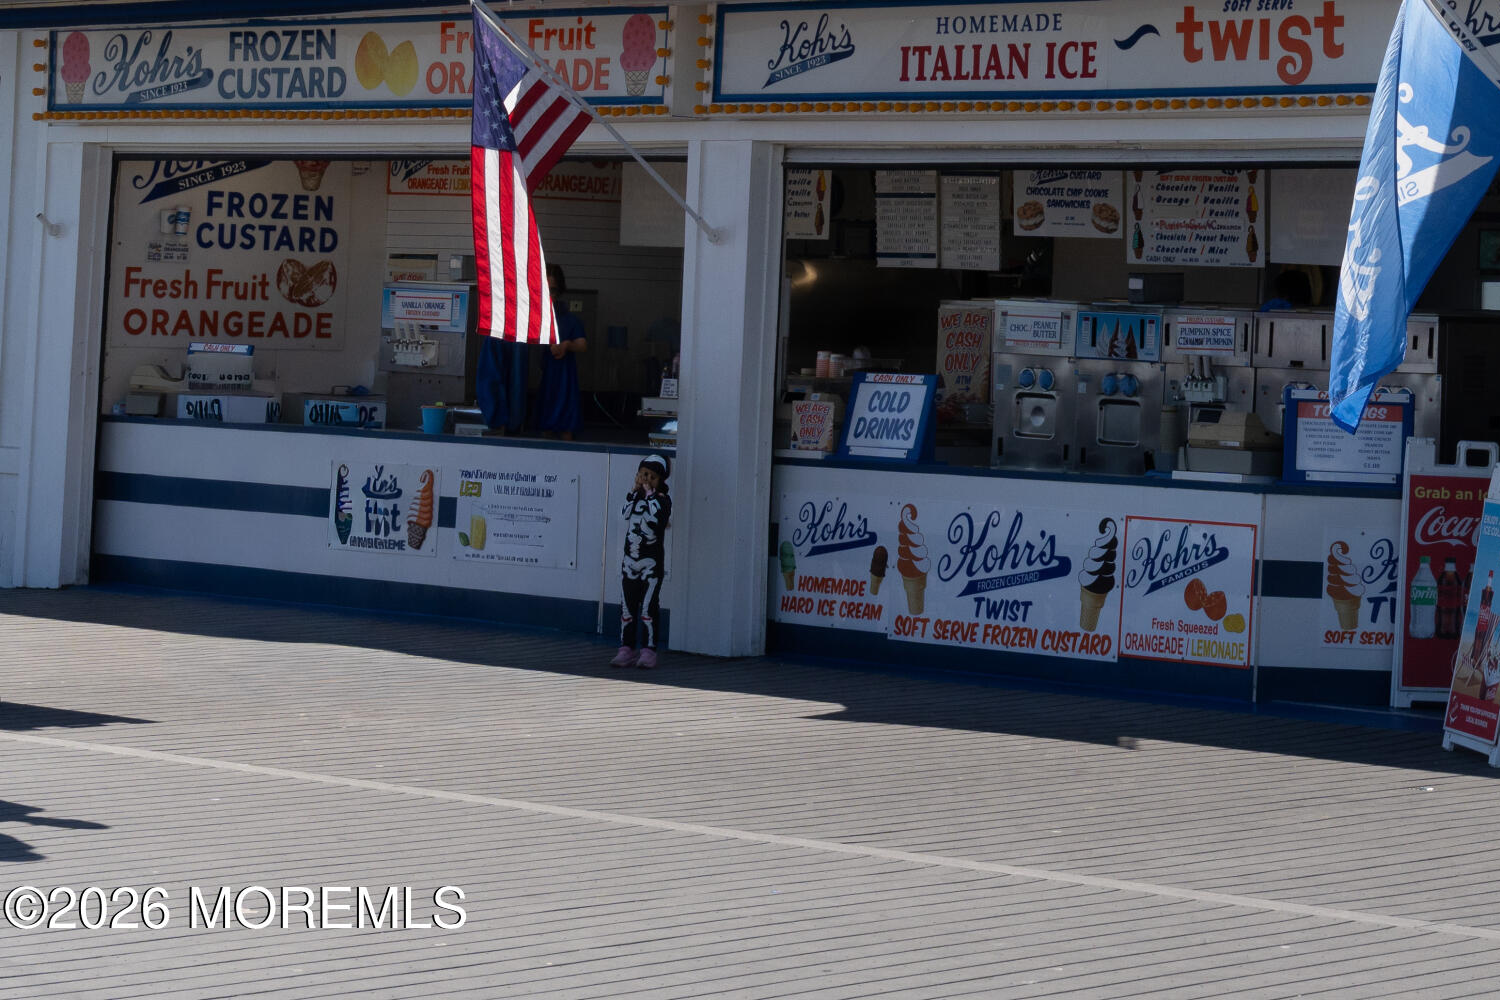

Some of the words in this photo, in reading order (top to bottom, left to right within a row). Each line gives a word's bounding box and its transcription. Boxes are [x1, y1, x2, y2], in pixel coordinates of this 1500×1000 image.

[528, 17, 596, 51] Fruit
[936, 13, 1063, 34] HOMEMADE
[229, 29, 337, 61] FROZEN
[768, 13, 853, 70] Kohr's
[93, 30, 204, 96] Kohr's
[775, 63, 801, 80] SINCE
[806, 55, 826, 70] 1923
[900, 43, 1031, 82] ITALIAN
[1045, 41, 1098, 79] ICE
[140, 85, 168, 100] SINCE
[170, 81, 189, 94] 1923
[217, 67, 347, 100] CUSTARD
[178, 170, 214, 191] SINCE
[220, 160, 247, 178] 1923
[427, 164, 449, 175] Fresh
[452, 165, 470, 175] Fruit
[407, 178, 448, 190] ORANGEADE
[1026, 187, 1065, 197] CHOCOLATE
[1066, 188, 1083, 197] CHIP
[1084, 188, 1109, 198] COOKIE
[1156, 183, 1197, 192] Chocolate
[1208, 184, 1240, 192] Vanilla
[206, 190, 334, 221] FROZEN
[1046, 198, 1091, 209] SANDWICHES
[1156, 195, 1190, 206] Orange
[1203, 195, 1240, 205] Vanilla
[1209, 208, 1240, 217] Vanilla
[196, 222, 338, 253] CUSTARD
[1156, 232, 1187, 241] Chocolate
[1195, 233, 1217, 241] Peanut
[1219, 233, 1240, 242] Butter
[1156, 244, 1197, 254] Chocolate
[1208, 245, 1229, 255] Mint
[124, 267, 198, 299] Fresh
[206, 269, 269, 300] Fruit
[123, 308, 333, 338] ORANGEADE
[940, 312, 959, 330] WE
[963, 312, 989, 329] ARE
[1033, 320, 1058, 330] PEANUT
[945, 331, 982, 349] CASH
[1032, 330, 1057, 339] BUTTER
[1180, 327, 1210, 336] PUMPKIN
[1211, 328, 1232, 337] SPICE
[1205, 337, 1233, 345] PUMPKIN
[944, 352, 981, 373] ONLY
[873, 374, 893, 383] CASH
[895, 375, 916, 383] ONLY
[955, 375, 972, 385] ATM
[867, 390, 911, 413] COLD
[1313, 405, 1388, 419] TONGS
[800, 414, 824, 424] CASH
[853, 417, 915, 441] DRINKS
[800, 426, 823, 439] ONLY
[1414, 486, 1451, 499] Grab
[1455, 490, 1473, 500] an
[792, 501, 870, 547] Kohr's
[937, 510, 1059, 582] Kohr's
[1127, 525, 1219, 588] Kohr's
[976, 577, 1004, 592] FROZEN
[1005, 571, 1040, 587] CUSTARD
[1160, 560, 1210, 587] FAMOUS
[798, 575, 867, 597] HOMEMADE
[781, 596, 814, 614] HARD
[817, 598, 836, 617] ICE
[839, 601, 883, 622] CREAM
[974, 597, 1033, 623] TWIST
[894, 615, 929, 638] SOFT
[932, 619, 977, 643] SERVE
[982, 623, 1038, 649] FROZEN
[1040, 630, 1113, 657] CUSTARD
[1151, 617, 1175, 632] Fresh
[1177, 619, 1219, 637] Squeezed
[1124, 632, 1184, 655] ORANGEADE
[1191, 639, 1245, 662] LEMONADE
[1323, 630, 1357, 645] SOFT
[1359, 630, 1395, 646] SERV
